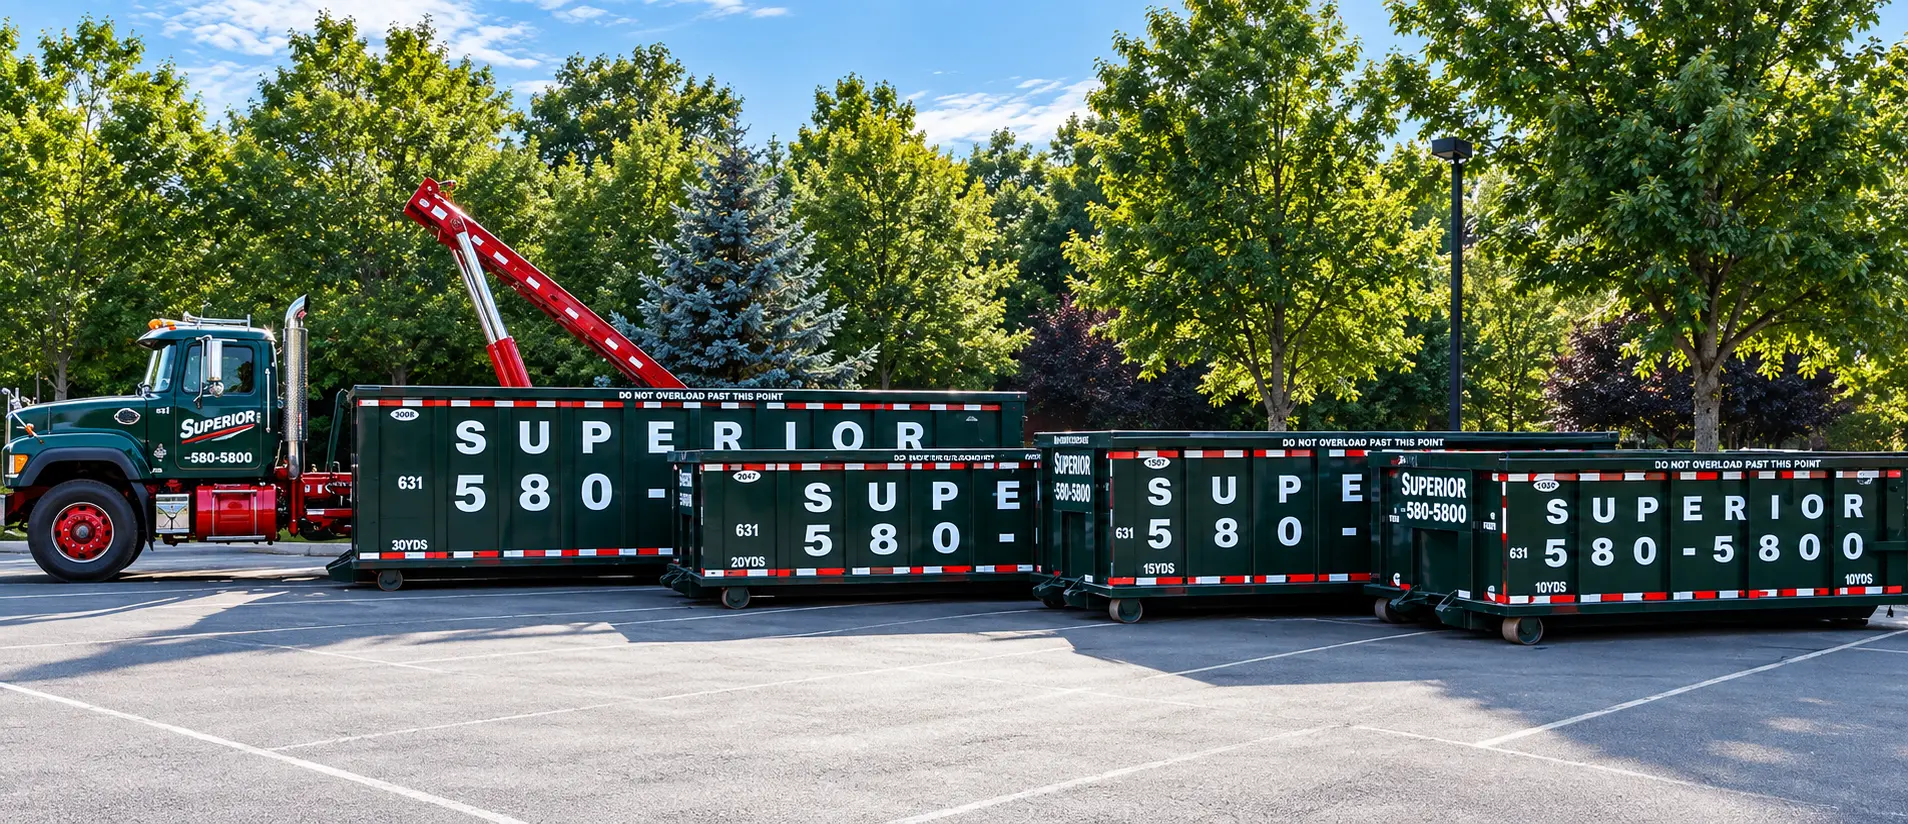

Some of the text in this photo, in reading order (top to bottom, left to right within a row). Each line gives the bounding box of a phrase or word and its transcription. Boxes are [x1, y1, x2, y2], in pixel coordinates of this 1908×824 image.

[619, 391, 784, 401] DO NOT OVERLOAD PAST THIS POINT
[180, 409, 256, 439] SUPERIOR
[1282, 438, 1445, 447] DO NOT OVERLOAD PAST THIS POINT
[1054, 451, 1091, 476] SUPERIOR
[1654, 459, 1822, 469] DO NOT OVERLOAD PAST THIS POINT
[397, 475, 423, 490] 631
[1401, 472, 1467, 499] SUPERIOR
[735, 523, 759, 537] 631
[1115, 526, 1134, 539] 631
[391, 539, 428, 551] 30YDS
[1509, 546, 1528, 559] 631
[730, 555, 766, 567] 20YDS
[1143, 562, 1175, 575] 15YDS
[1535, 581, 1567, 594] 10YDS
